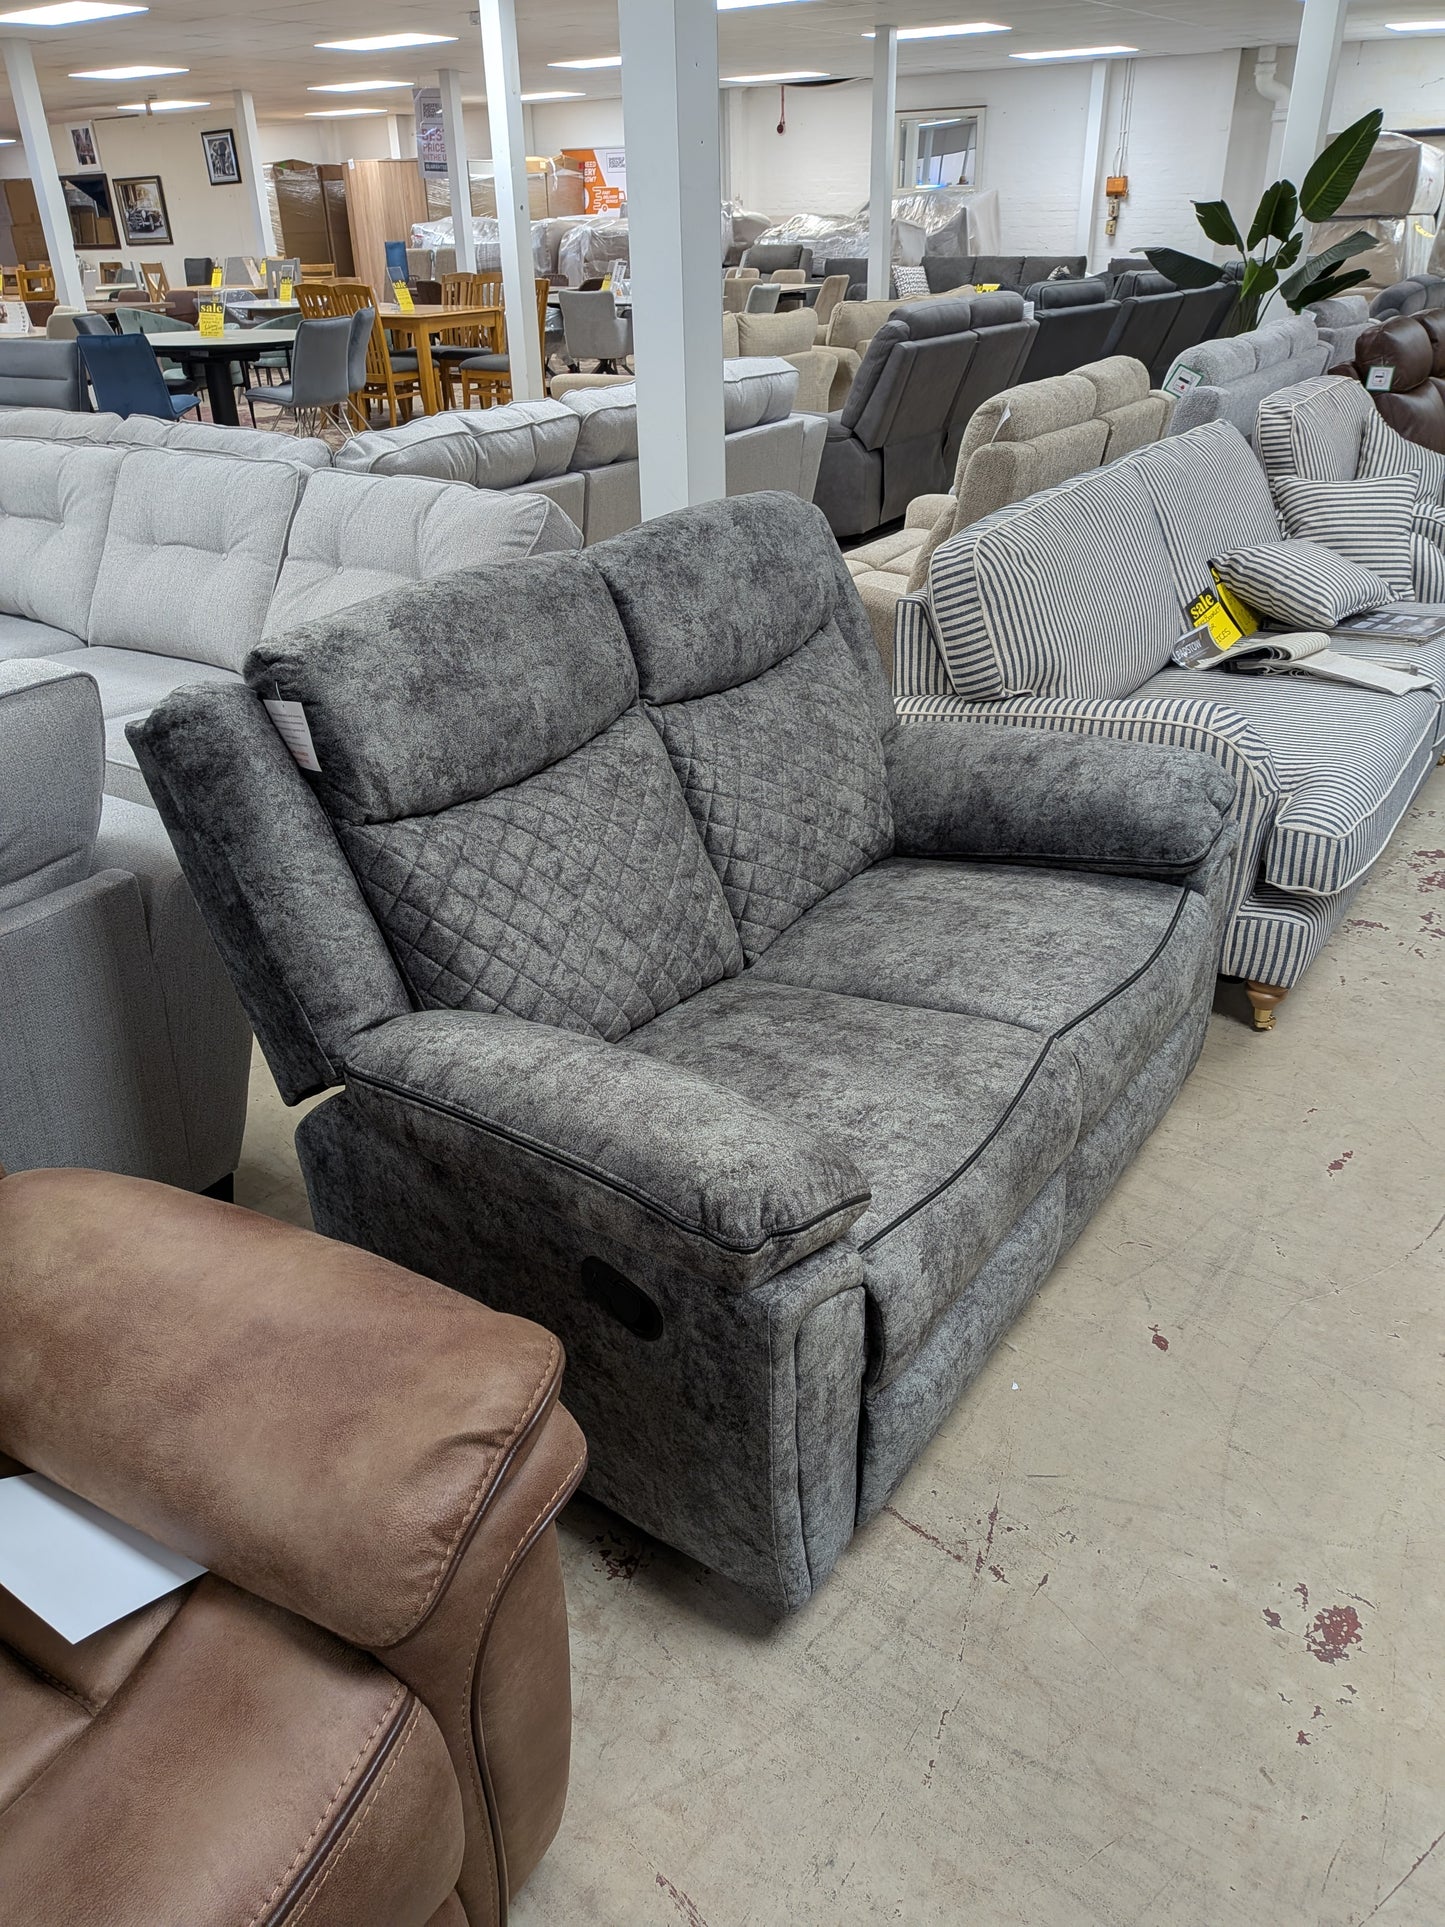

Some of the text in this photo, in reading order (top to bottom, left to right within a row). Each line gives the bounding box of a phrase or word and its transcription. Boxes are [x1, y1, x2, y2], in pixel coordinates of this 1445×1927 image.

[422, 128, 444, 142] BES
[423, 144, 446, 152] PRICE
[200, 303, 223, 313] sale
[1190, 594, 1215, 620] sale
